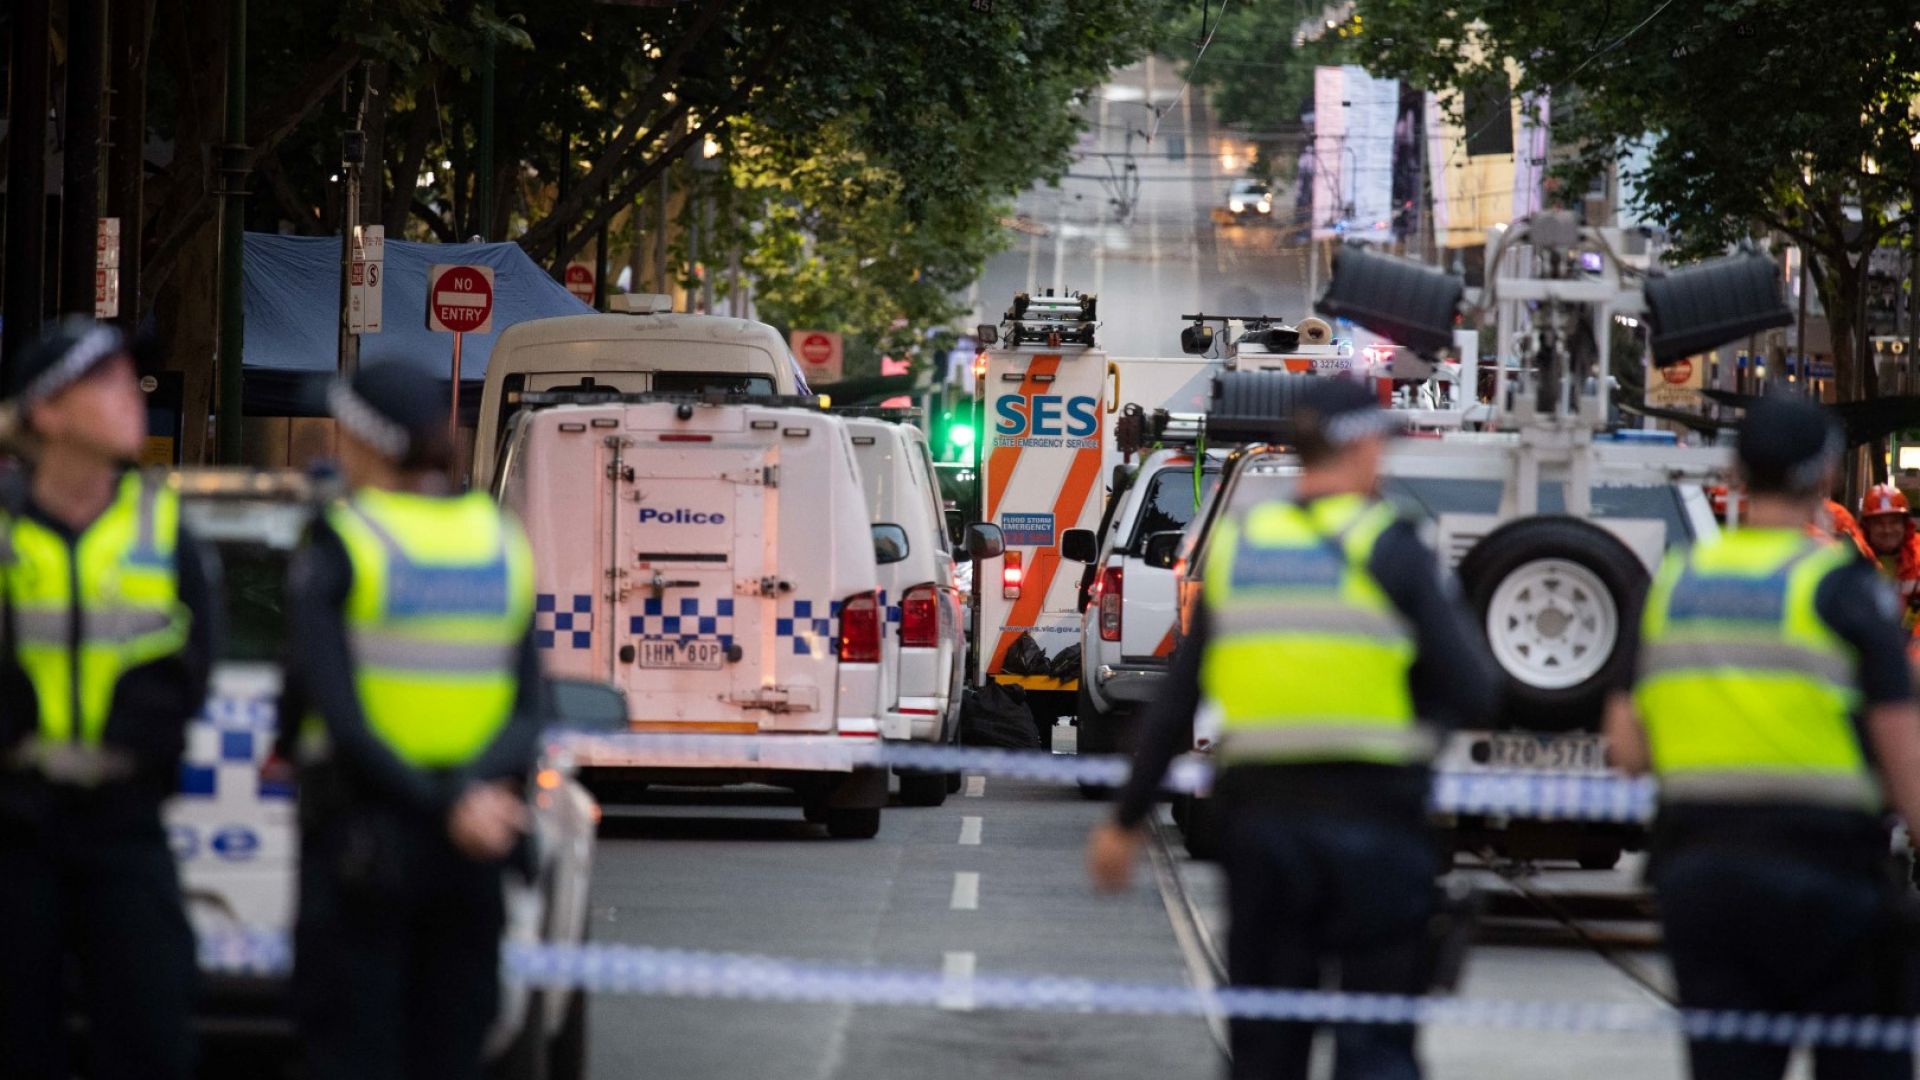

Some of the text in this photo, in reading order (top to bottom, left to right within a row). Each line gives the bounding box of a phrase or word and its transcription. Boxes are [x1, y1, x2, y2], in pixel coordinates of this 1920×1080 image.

[454, 277, 473, 291] NO
[441, 307, 482, 321] ENTRY
[995, 394, 1098, 437] SES
[993, 438, 1097, 448] STATE EMERGENCY SERVICE
[639, 508, 726, 525] Police
